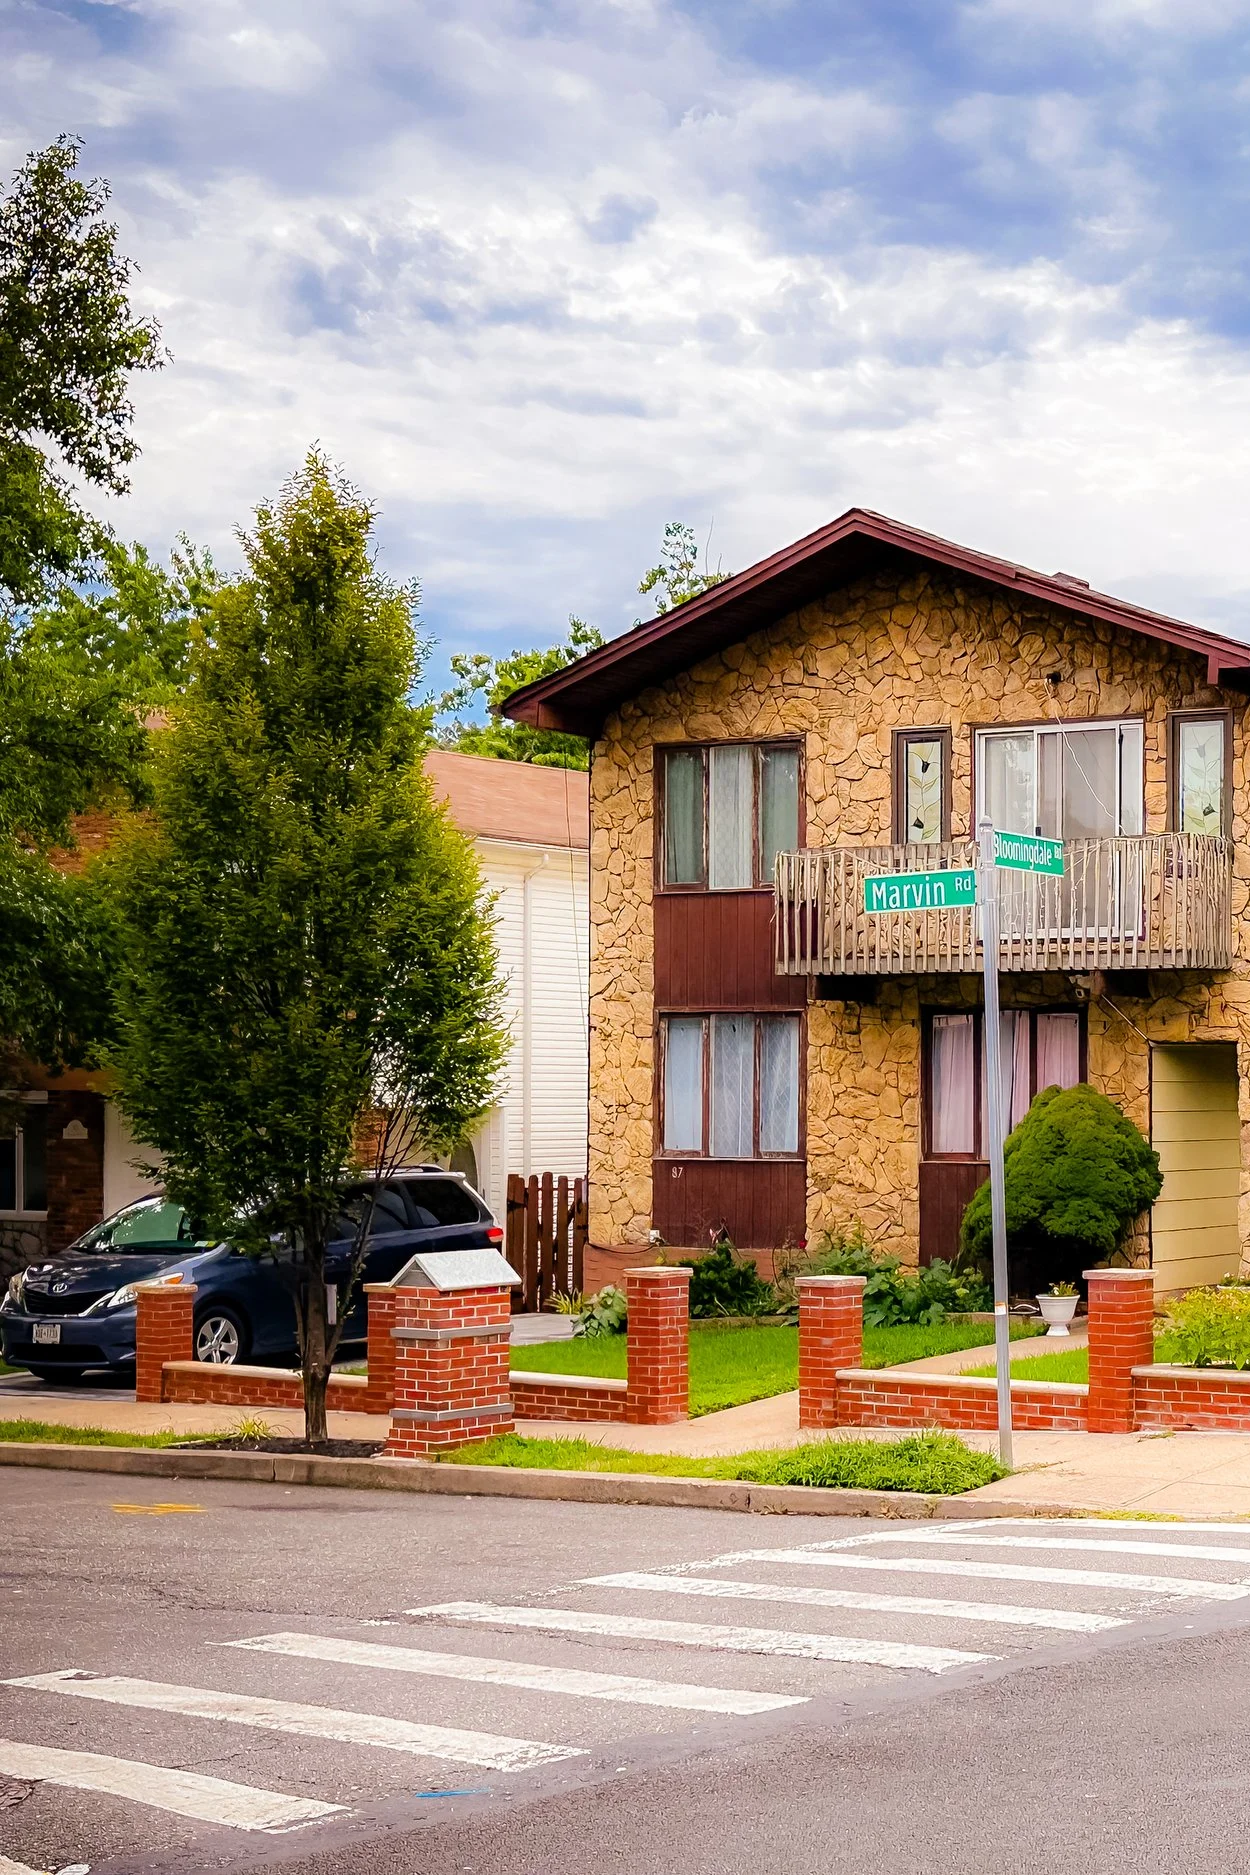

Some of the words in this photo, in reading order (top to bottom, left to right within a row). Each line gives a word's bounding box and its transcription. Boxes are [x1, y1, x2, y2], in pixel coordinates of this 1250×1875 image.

[994, 836, 1052, 869] Bloomingdale
[1054, 844, 1062, 859] Rd
[872, 875, 945, 909] Marvin
[955, 877, 971, 891] Rd
[671, 1166, 683, 1178] 87
